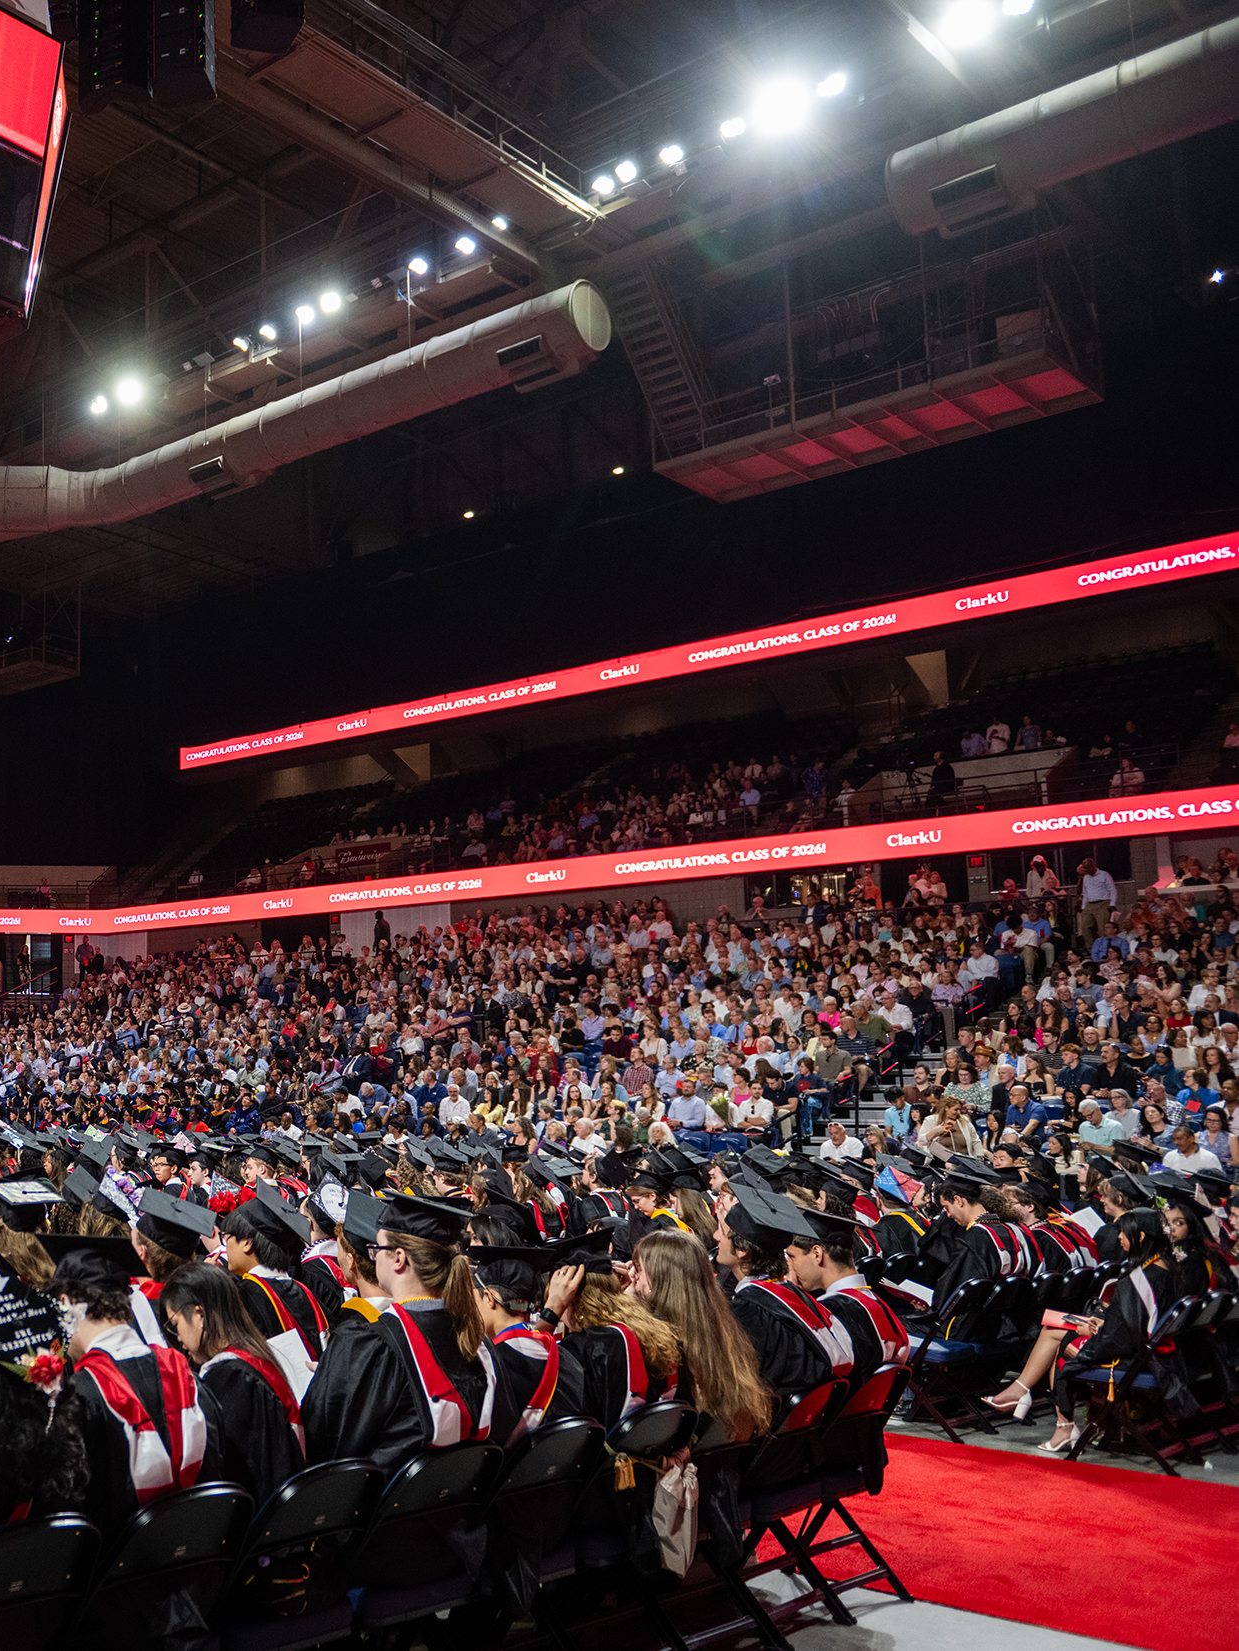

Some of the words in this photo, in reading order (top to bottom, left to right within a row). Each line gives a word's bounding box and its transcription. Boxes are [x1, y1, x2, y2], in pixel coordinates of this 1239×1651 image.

[1077, 546, 1236, 586] CONGRATULATIONS,
[955, 590, 1009, 611] ClarkU
[688, 632, 802, 663] CONGRATULATIONS,
[803, 624, 841, 641] CLASS
[842, 620, 861, 633] OF
[862, 613, 897, 630] 2026!
[599, 663, 640, 681] ClarkU
[403, 694, 488, 719] CONGRATULATIONS,
[488, 688, 517, 702] CLASS
[516, 685, 531, 696] OF
[531, 680, 557, 694] 2026!
[336, 718, 367, 732] ClarkU
[185, 741, 251, 761] CONGRATULATIONS,
[251, 737, 273, 748] CLASS
[273, 734, 284, 744] OF
[284, 731, 304, 742] 2026!
[1011, 806, 1175, 834] CONGRATULATIONS,
[1177, 799, 1233, 817] CLASS
[886, 829, 942, 847] ClarkU
[614, 852, 731, 875] CONGRATULATIONS,
[731, 848, 770, 863] CLASS
[770, 846, 790, 859] OF
[791, 842, 827, 857] 2026!
[525, 869, 567, 884] ClarkU
[328, 885, 414, 903] CONGRATULATIONS,
[413, 882, 442, 895] CLASS
[442, 880, 457, 892] OF
[457, 878, 483, 891] 2026!
[262, 897, 294, 910] ClarkU
[0, 916, 21, 926] 2026!
[58, 916, 92, 927] ClarkU
[113, 910, 178, 925] CONGRATULATIONS,
[178, 908, 200, 918] CLASS
[199, 906, 211, 916] OF
[211, 904, 231, 915] 2026!
